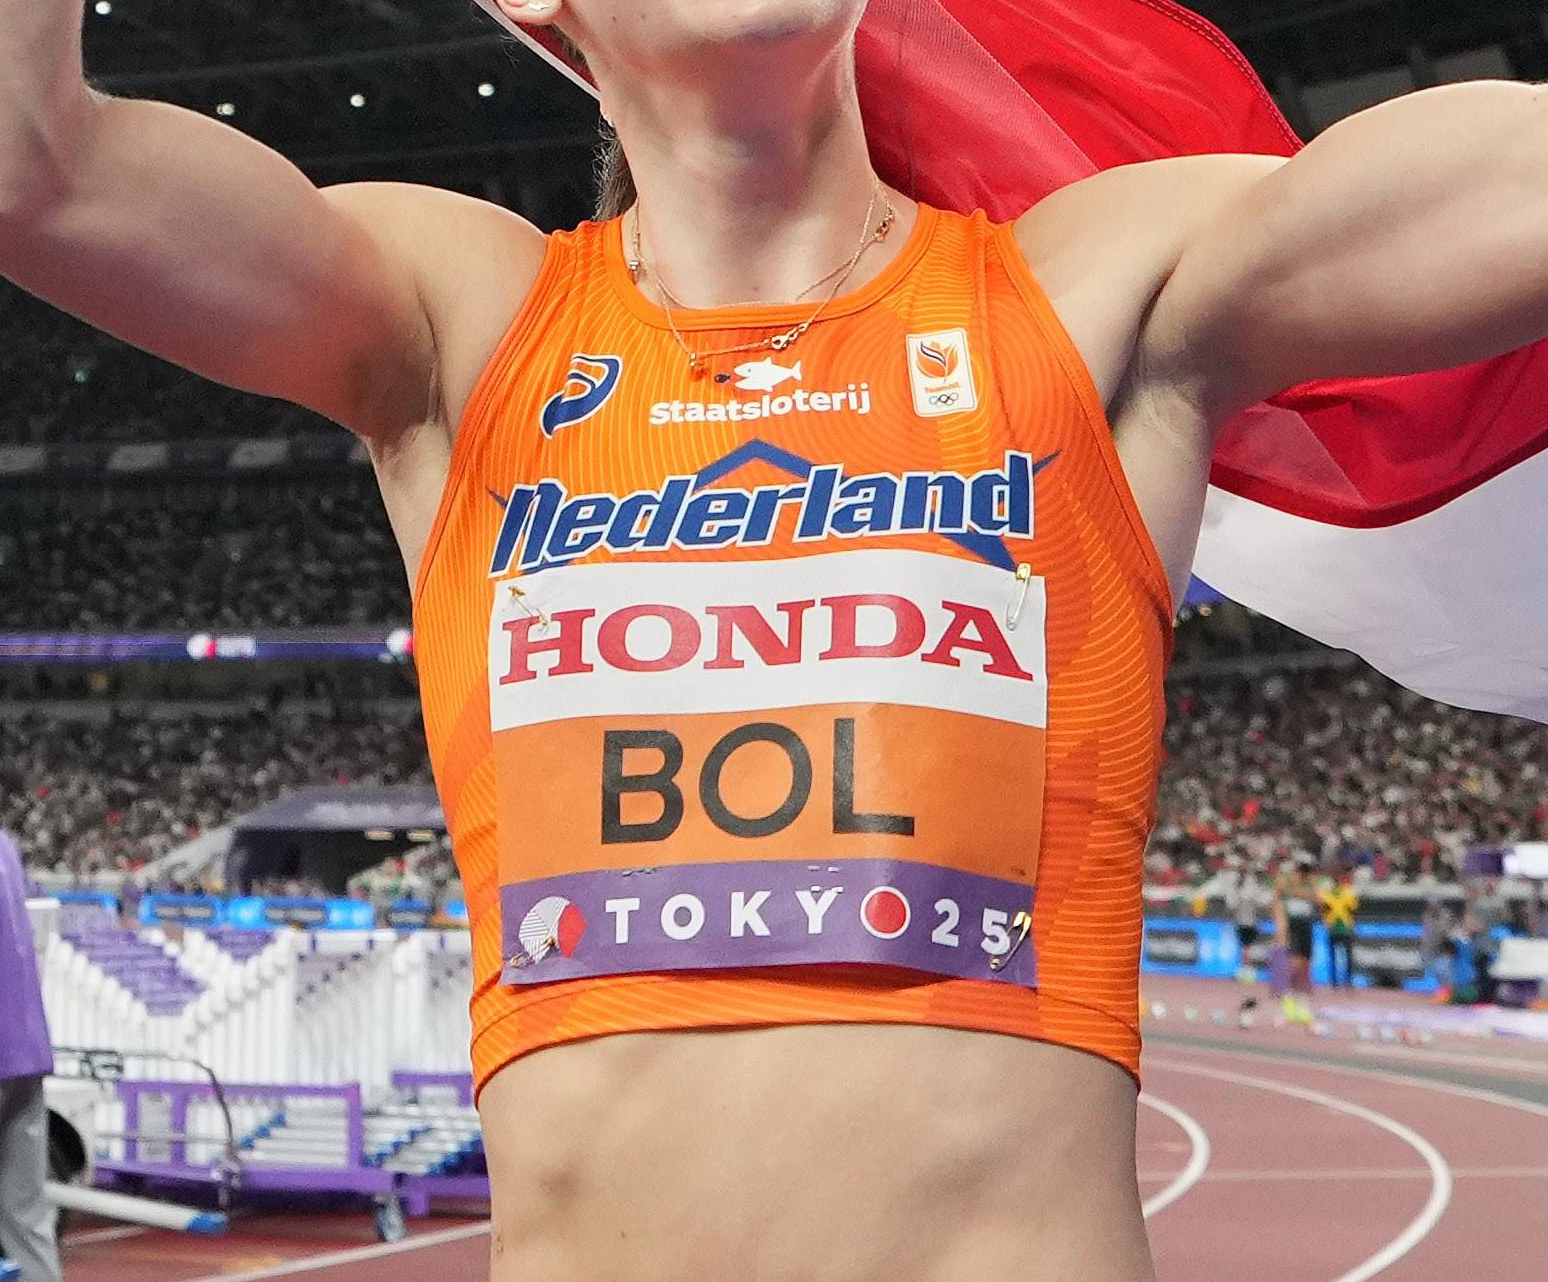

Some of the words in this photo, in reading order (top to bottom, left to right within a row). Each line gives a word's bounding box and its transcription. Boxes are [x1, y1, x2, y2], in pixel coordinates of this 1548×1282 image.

[649, 382, 871, 425] Staatsloterij
[499, 593, 1034, 685] HONDA
[600, 718, 916, 845] BOL
